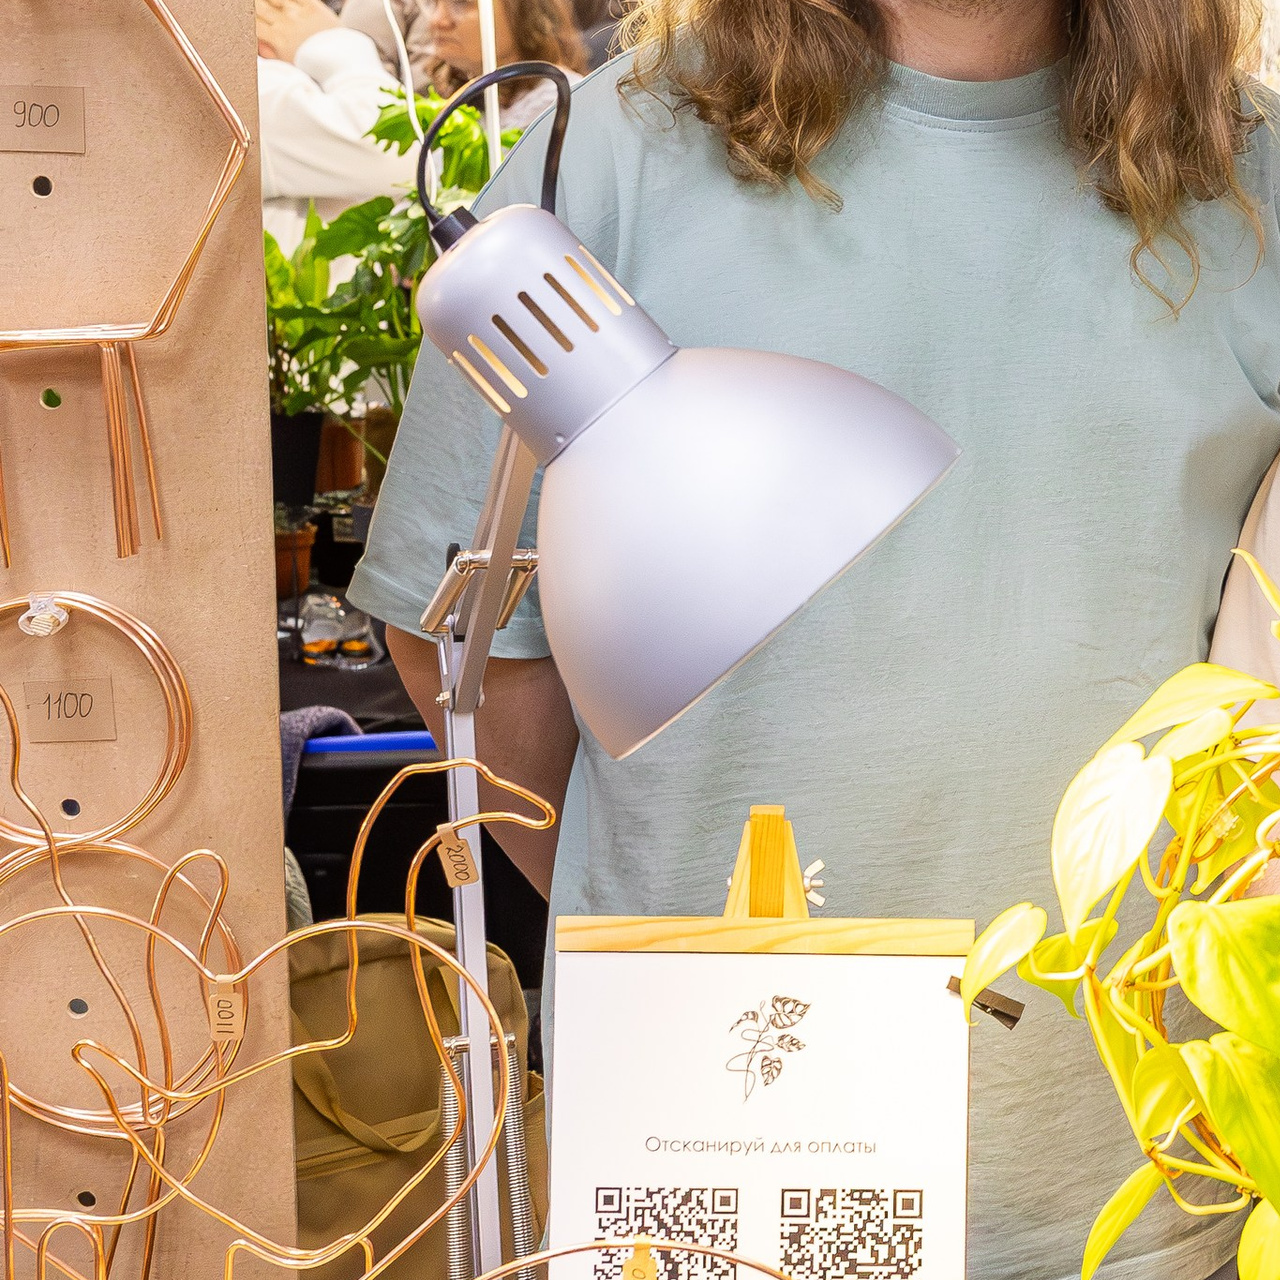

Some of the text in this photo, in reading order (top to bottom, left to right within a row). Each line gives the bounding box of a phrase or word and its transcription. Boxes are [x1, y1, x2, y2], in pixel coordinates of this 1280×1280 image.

[14, 100, 60, 128] 900
[43, 691, 94, 722] 1100
[441, 842, 472, 882] 2000
[215, 1000, 235, 1036] 1100
[645, 1135, 877, 1157] Отсканируй для оплаты
